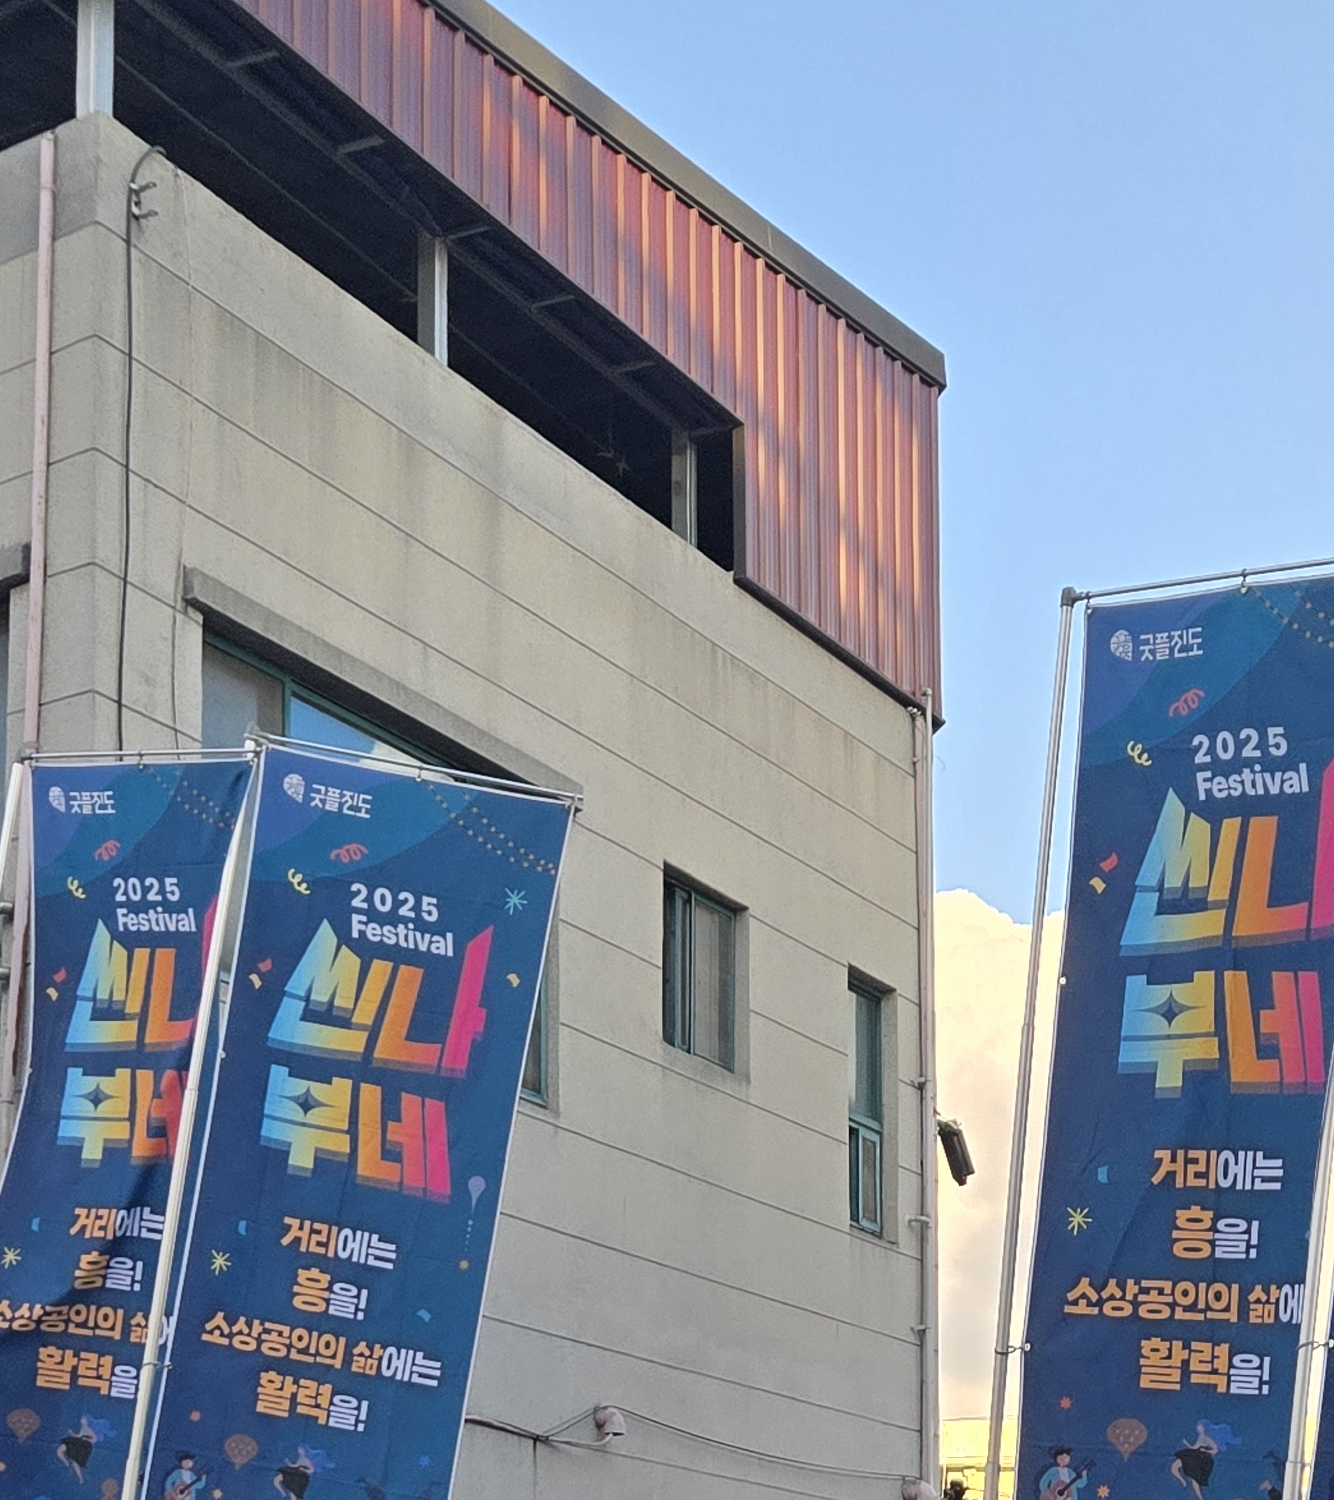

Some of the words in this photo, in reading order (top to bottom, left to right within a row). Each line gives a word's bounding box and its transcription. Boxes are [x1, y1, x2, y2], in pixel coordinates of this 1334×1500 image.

[1139, 627, 1204, 661] 굿플진도
[1192, 727, 1288, 764] 2025
[310, 785, 373, 818] 굿플진도
[1196, 763, 1310, 800] Festival
[113, 877, 180, 902] 2025
[350, 883, 439, 922] 2025
[116, 908, 196, 933] Festival
[351, 914, 454, 957] Festival
[1118, 970, 1326, 1097] 부네
[260, 1064, 451, 1203] 부네
[1151, 1149, 1284, 1190] 거리에는
[70, 1207, 165, 1240] 거리에는
[280, 1216, 397, 1270] 거리에는
[1172, 1205, 1260, 1259] 흥을!
[74, 1250, 143, 1291] 흥을!
[292, 1267, 368, 1320] 흥을!
[1064, 1277, 1240, 1322] 소상공인의
[1248, 1284, 1305, 1324] 삶에
[201, 1311, 346, 1369] 소상공인의
[351, 1341, 442, 1386] 삶에는
[1140, 1337, 1271, 1395] 활력을!
[36, 1345, 139, 1399] 활력을
[256, 1370, 369, 1432] 활력을!
